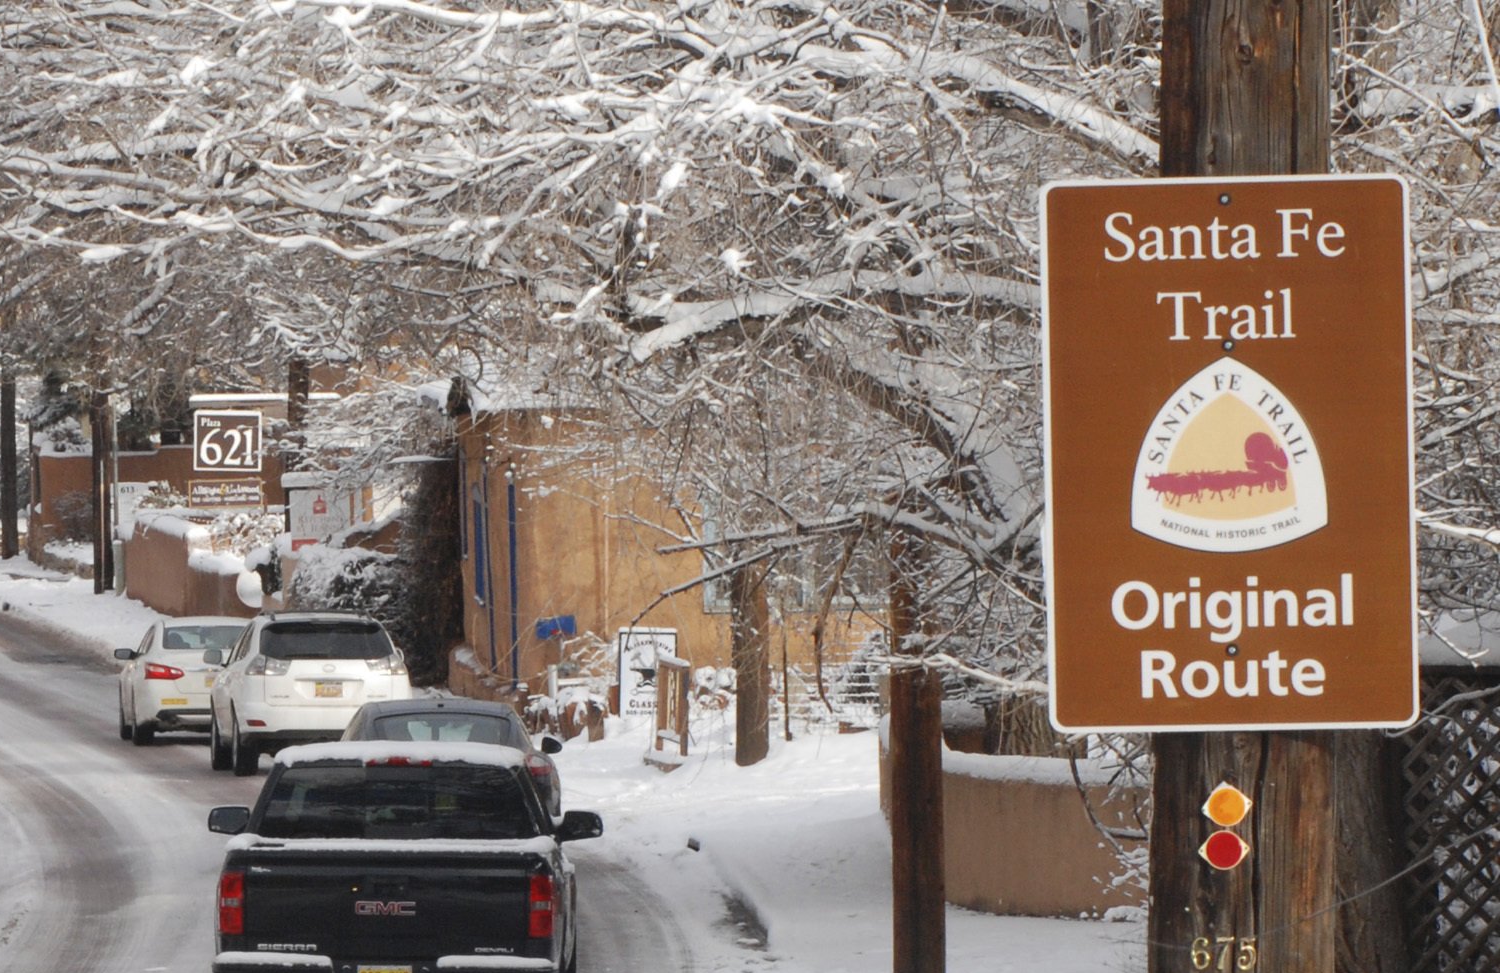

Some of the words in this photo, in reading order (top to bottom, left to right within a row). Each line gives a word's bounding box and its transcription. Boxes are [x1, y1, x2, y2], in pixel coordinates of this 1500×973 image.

[1103, 211, 1260, 262] Santa
[1276, 208, 1346, 258] Fe
[1156, 288, 1297, 341] Trail
[1148, 390, 1205, 465] SANTA
[1213, 373, 1243, 392] FE
[1257, 389, 1308, 465] TRAIL
[200, 427, 255, 466] 621
[1160, 518, 1210, 538] NATIONAL
[1215, 526, 1267, 540] HISTORIC
[1271, 516, 1302, 532] TRAIL
[1110, 573, 1354, 643] Original
[1140, 649, 1326, 698] Route
[355, 900, 416, 916] GMC
[257, 943, 317, 951] SIERRA
[1190, 936, 1257, 971] 675
